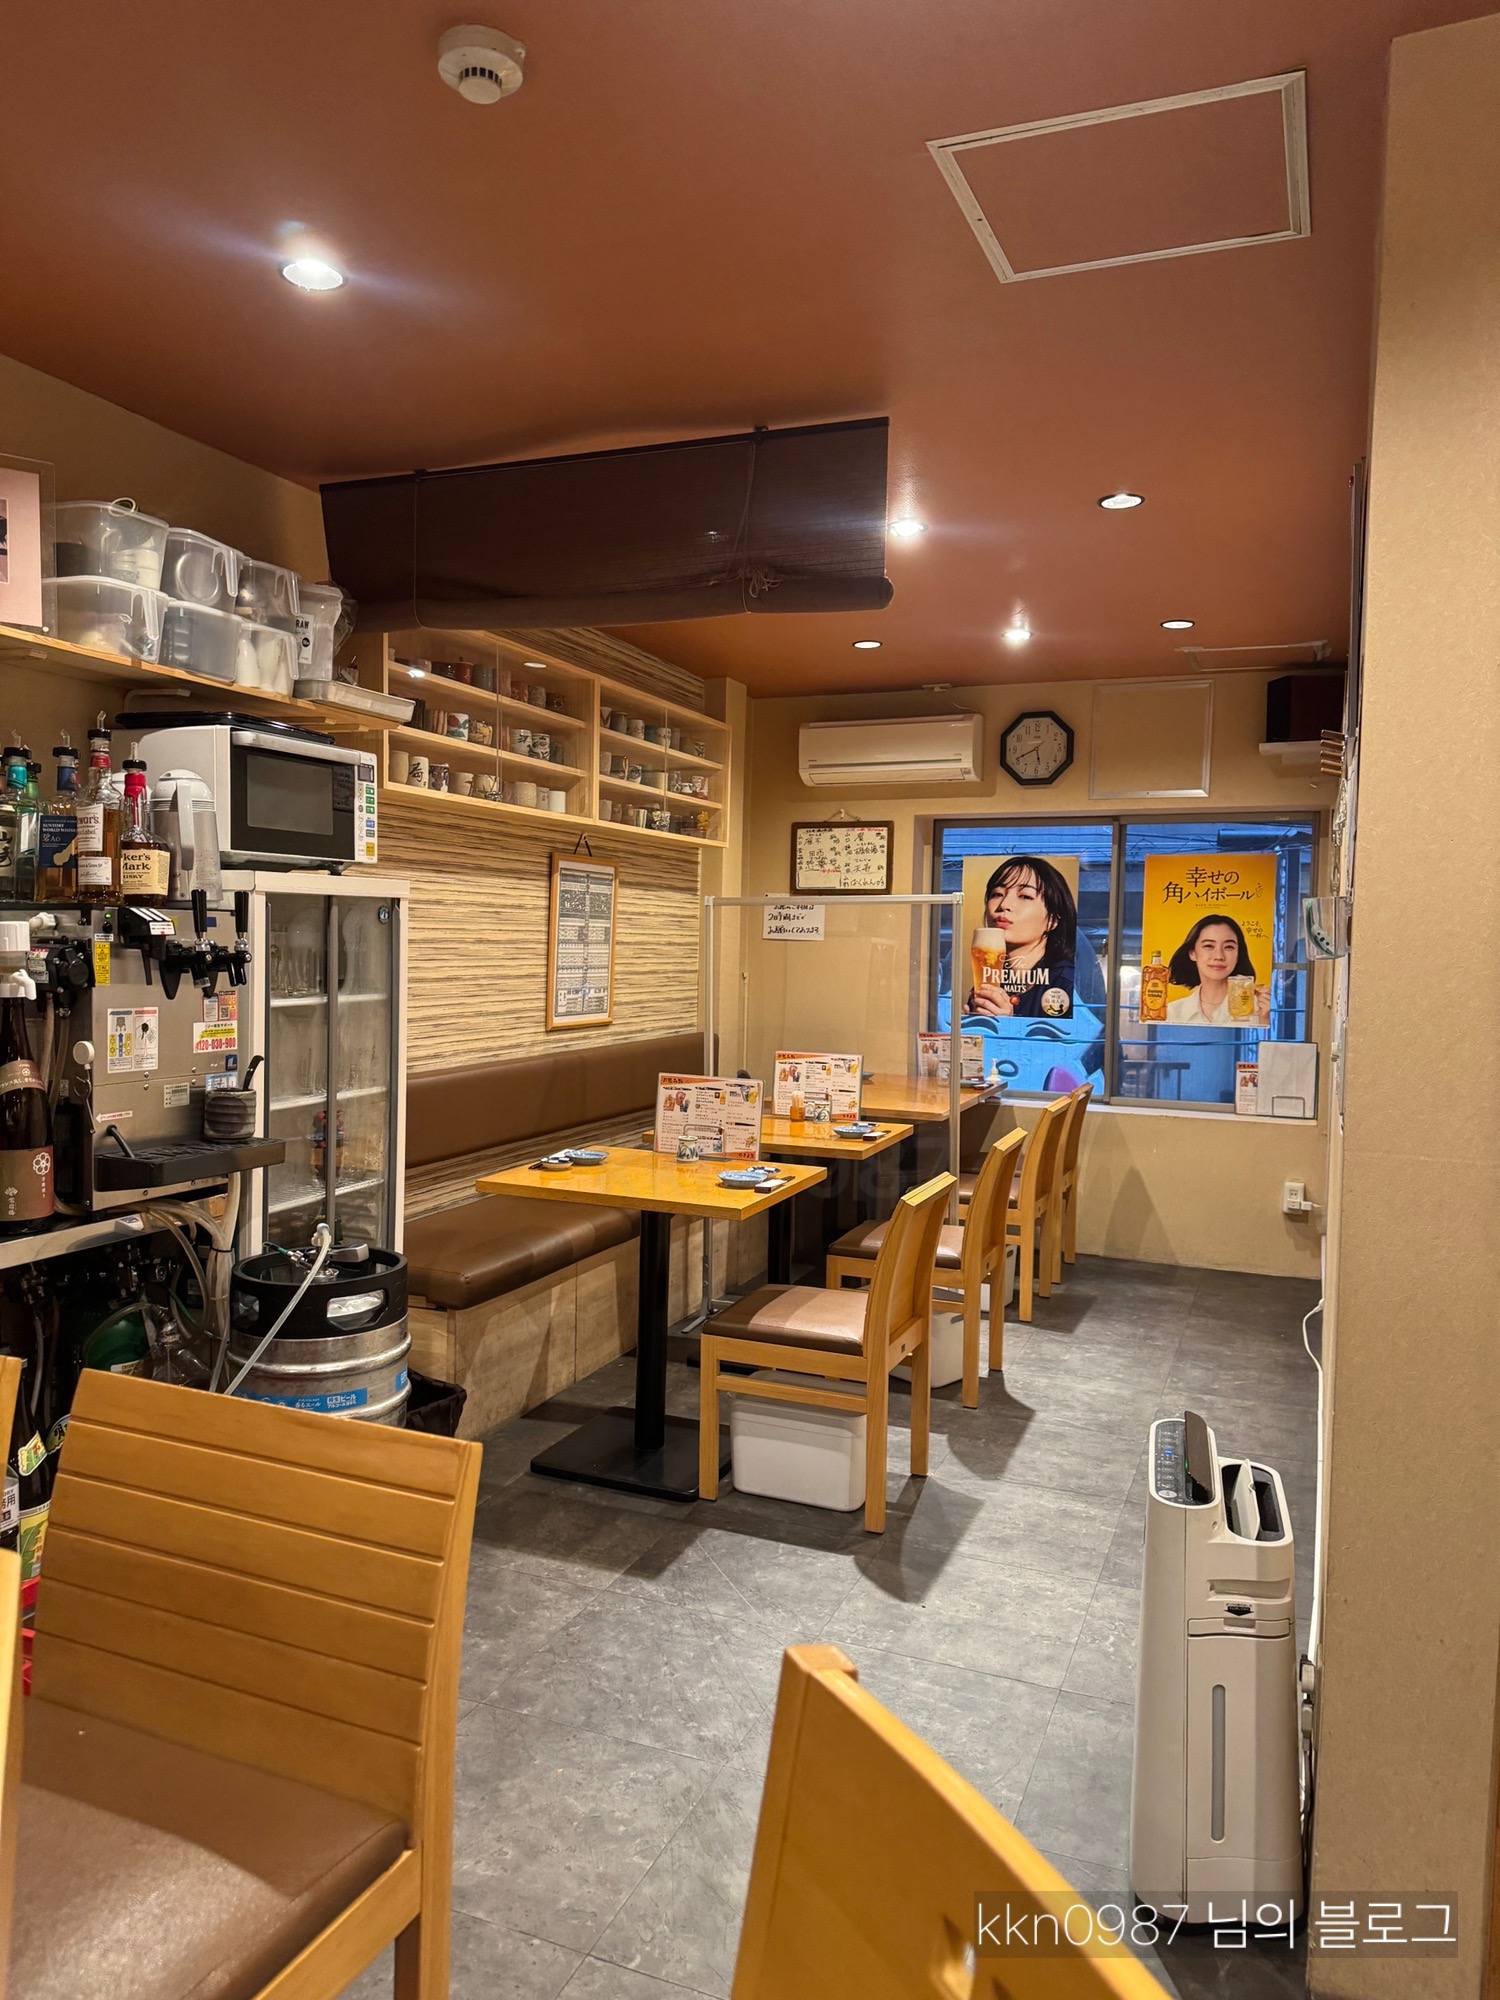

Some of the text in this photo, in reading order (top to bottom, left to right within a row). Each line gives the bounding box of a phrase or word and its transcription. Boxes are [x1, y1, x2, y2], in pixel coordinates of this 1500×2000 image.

[296, 619, 309, 629] RAW
[123, 853, 151, 861] ker's
[1186, 866, 1240, 888] 幸せの
[1162, 881, 1255, 904] 角ハイボール
[982, 966, 1050, 985] PREMIUM
